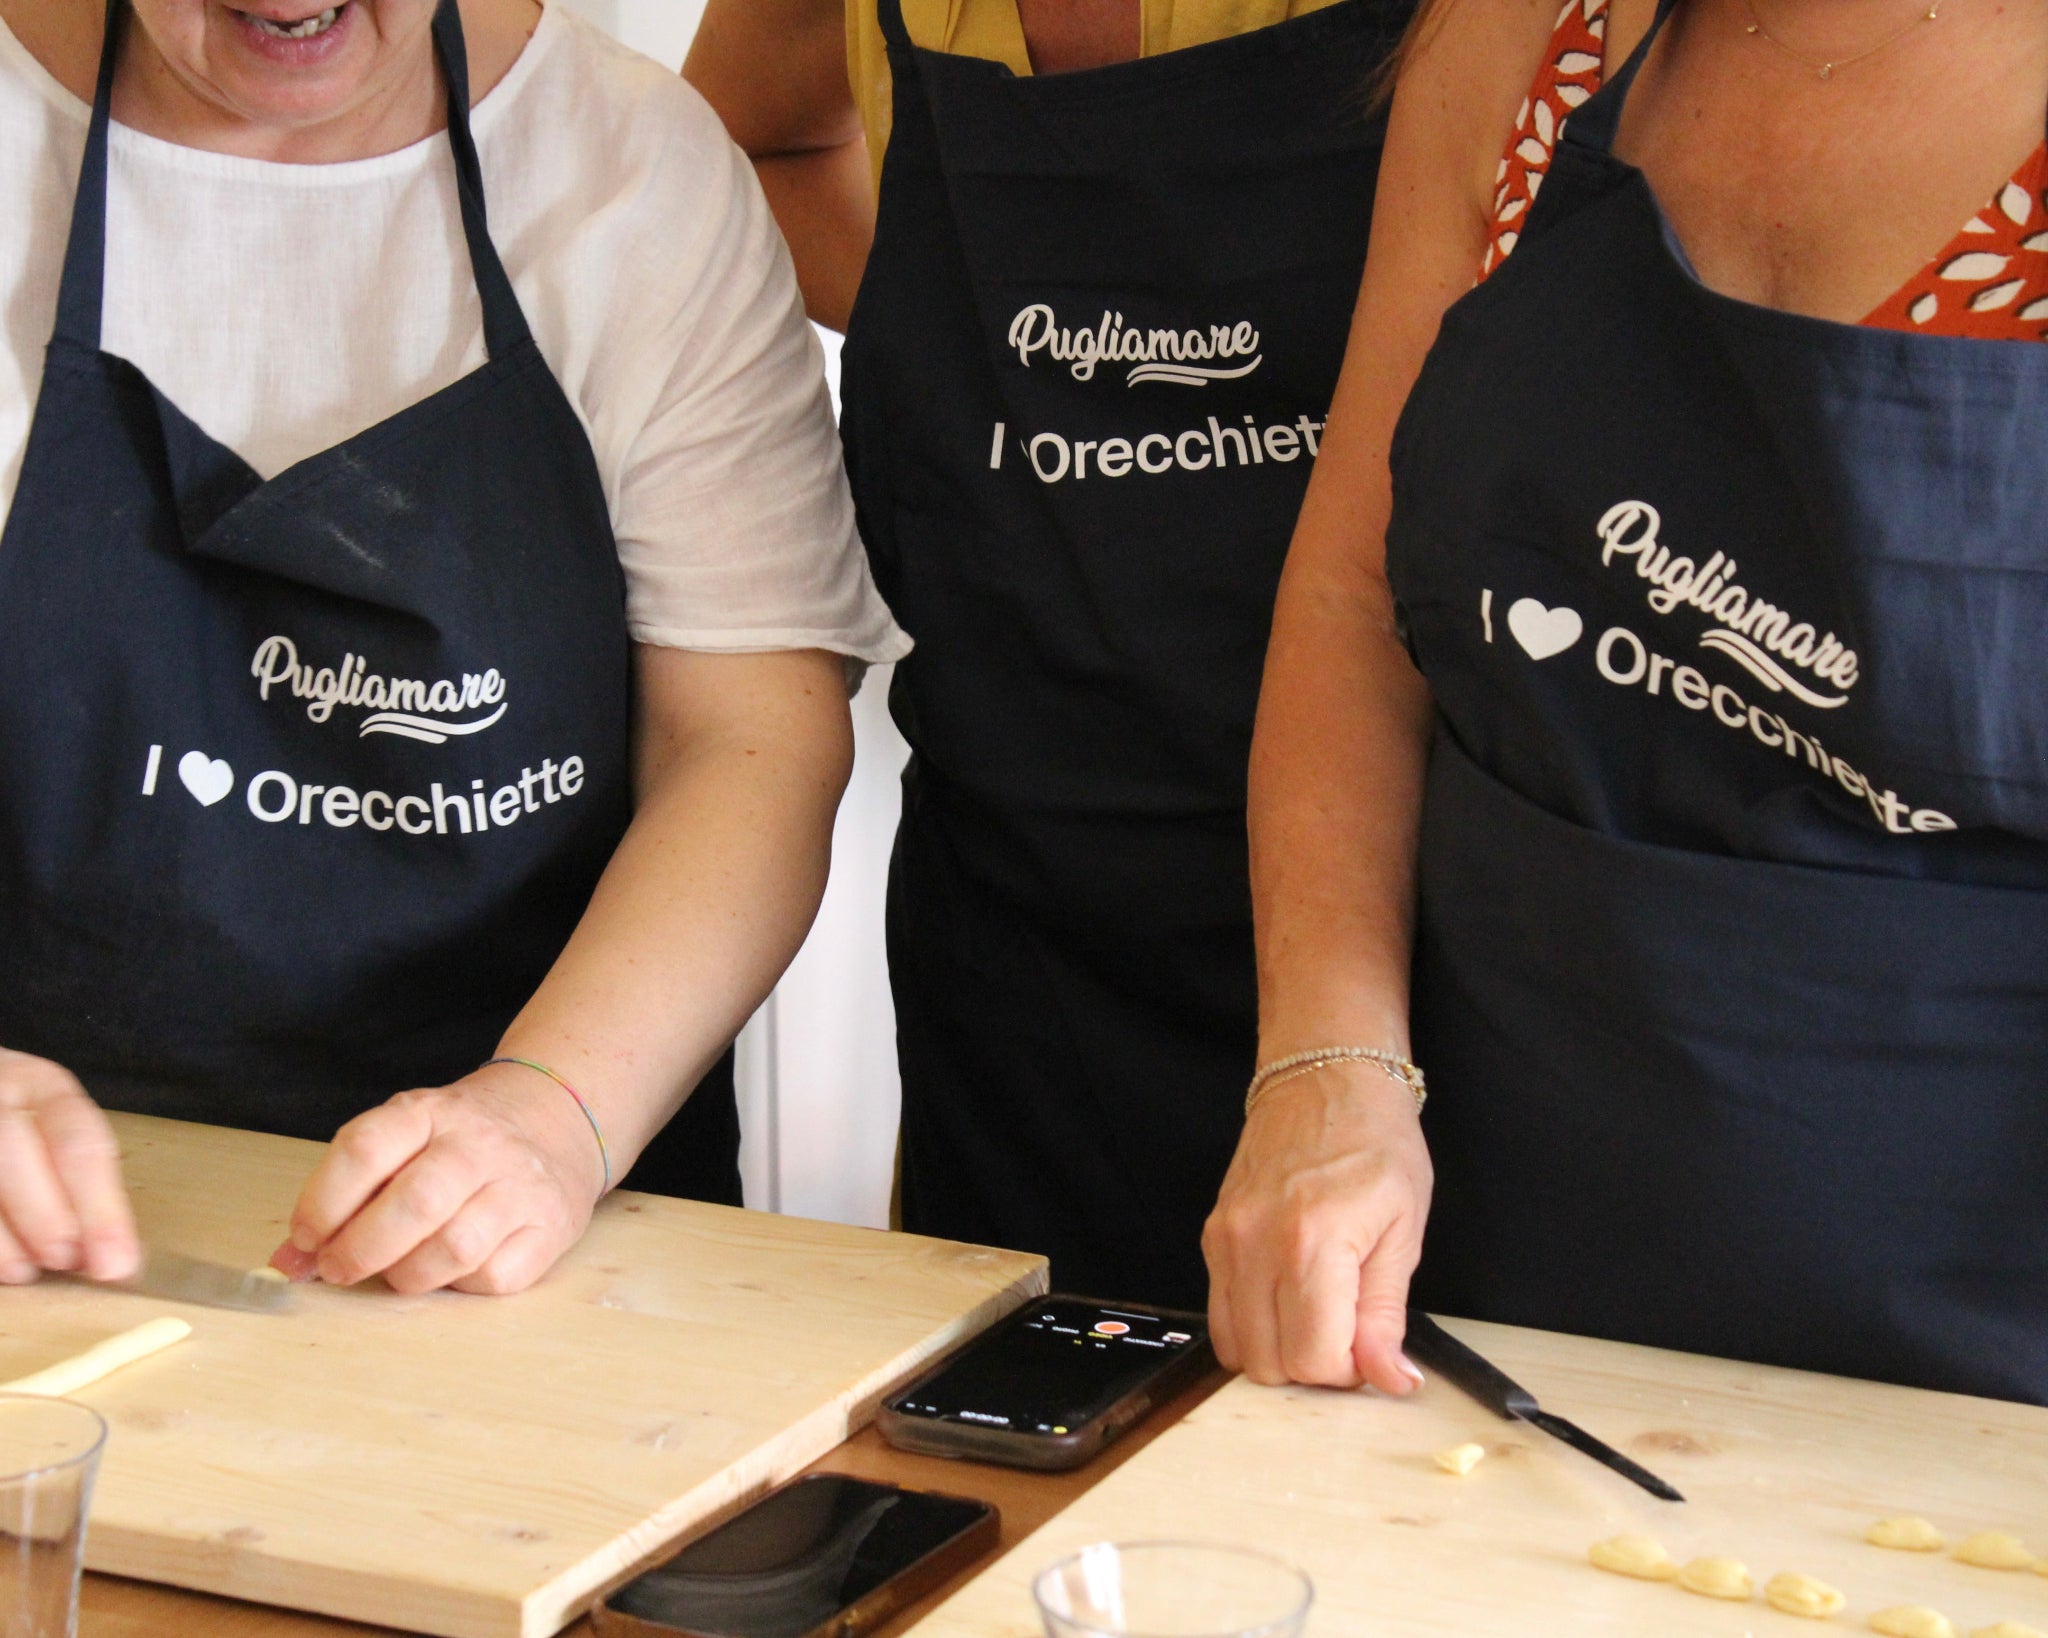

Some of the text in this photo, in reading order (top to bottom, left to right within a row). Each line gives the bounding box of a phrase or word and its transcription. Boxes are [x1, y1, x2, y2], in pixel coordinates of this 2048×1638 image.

[1008, 303, 1261, 382] Pugliamare
[990, 414, 1328, 483] I Orecchiet
[1481, 588, 1493, 643] I
[1596, 499, 1860, 690] Pugliamare
[250, 635, 507, 724] Pugliamare
[141, 744, 585, 835] I Orecchiette
